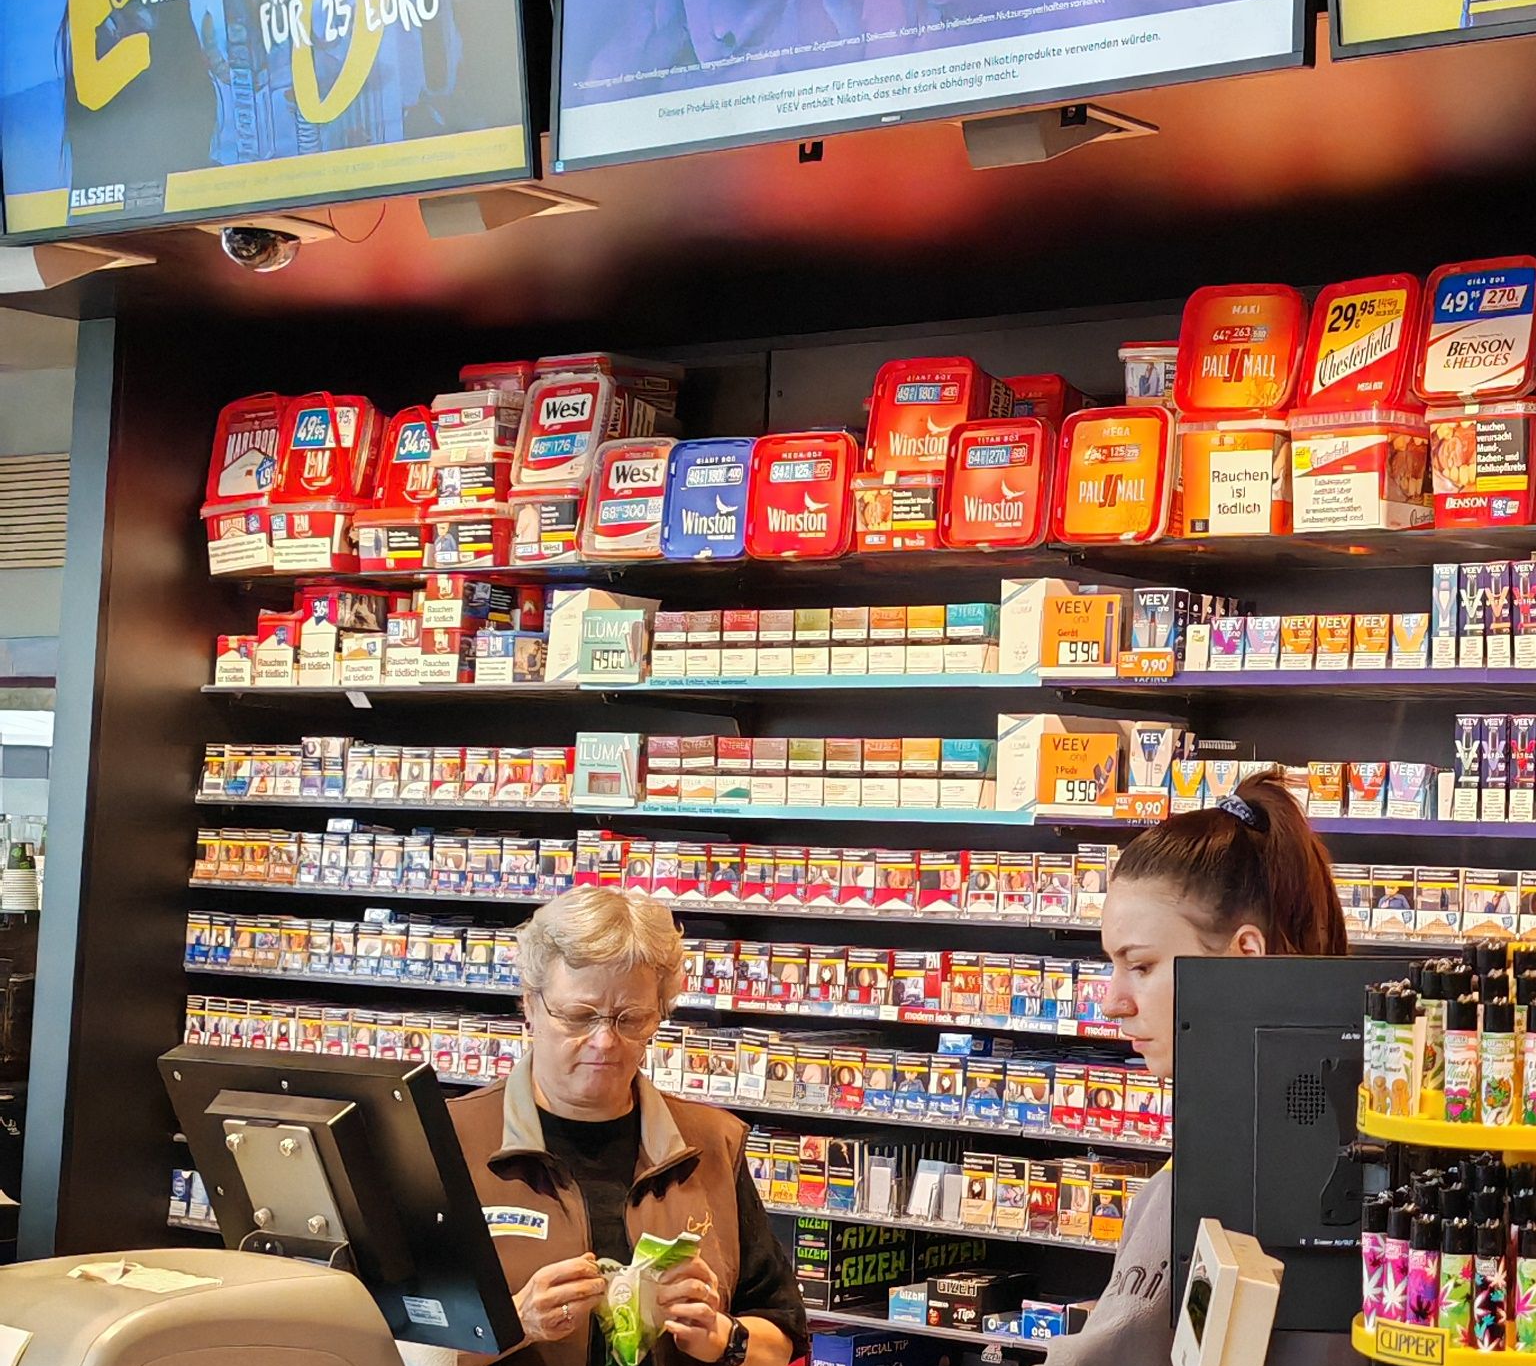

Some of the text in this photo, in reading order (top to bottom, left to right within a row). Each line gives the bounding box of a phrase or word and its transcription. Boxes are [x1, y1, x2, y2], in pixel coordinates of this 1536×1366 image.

[260, 0, 310, 54] FÜR
[71, 183, 125, 207] ELSSER
[1318, 321, 1393, 387] Chesterfield
[1446, 338, 1515, 358] BENSON
[1201, 353, 1276, 380] PALL MALL
[545, 396, 589, 421] West
[889, 431, 948, 458] Winston
[614, 460, 662, 486] West
[1212, 469, 1269, 483] Rauchen
[768, 503, 827, 532] Winston
[964, 495, 1023, 523] Winston
[1217, 499, 1261, 515] tödlich
[682, 505, 737, 539] Winston
[1055, 600, 1093, 614] VEEV
[584, 620, 630, 639] ILUMA
[1052, 737, 1090, 752] VEEV
[1379, 1328, 1437, 1357] CLIPPER
